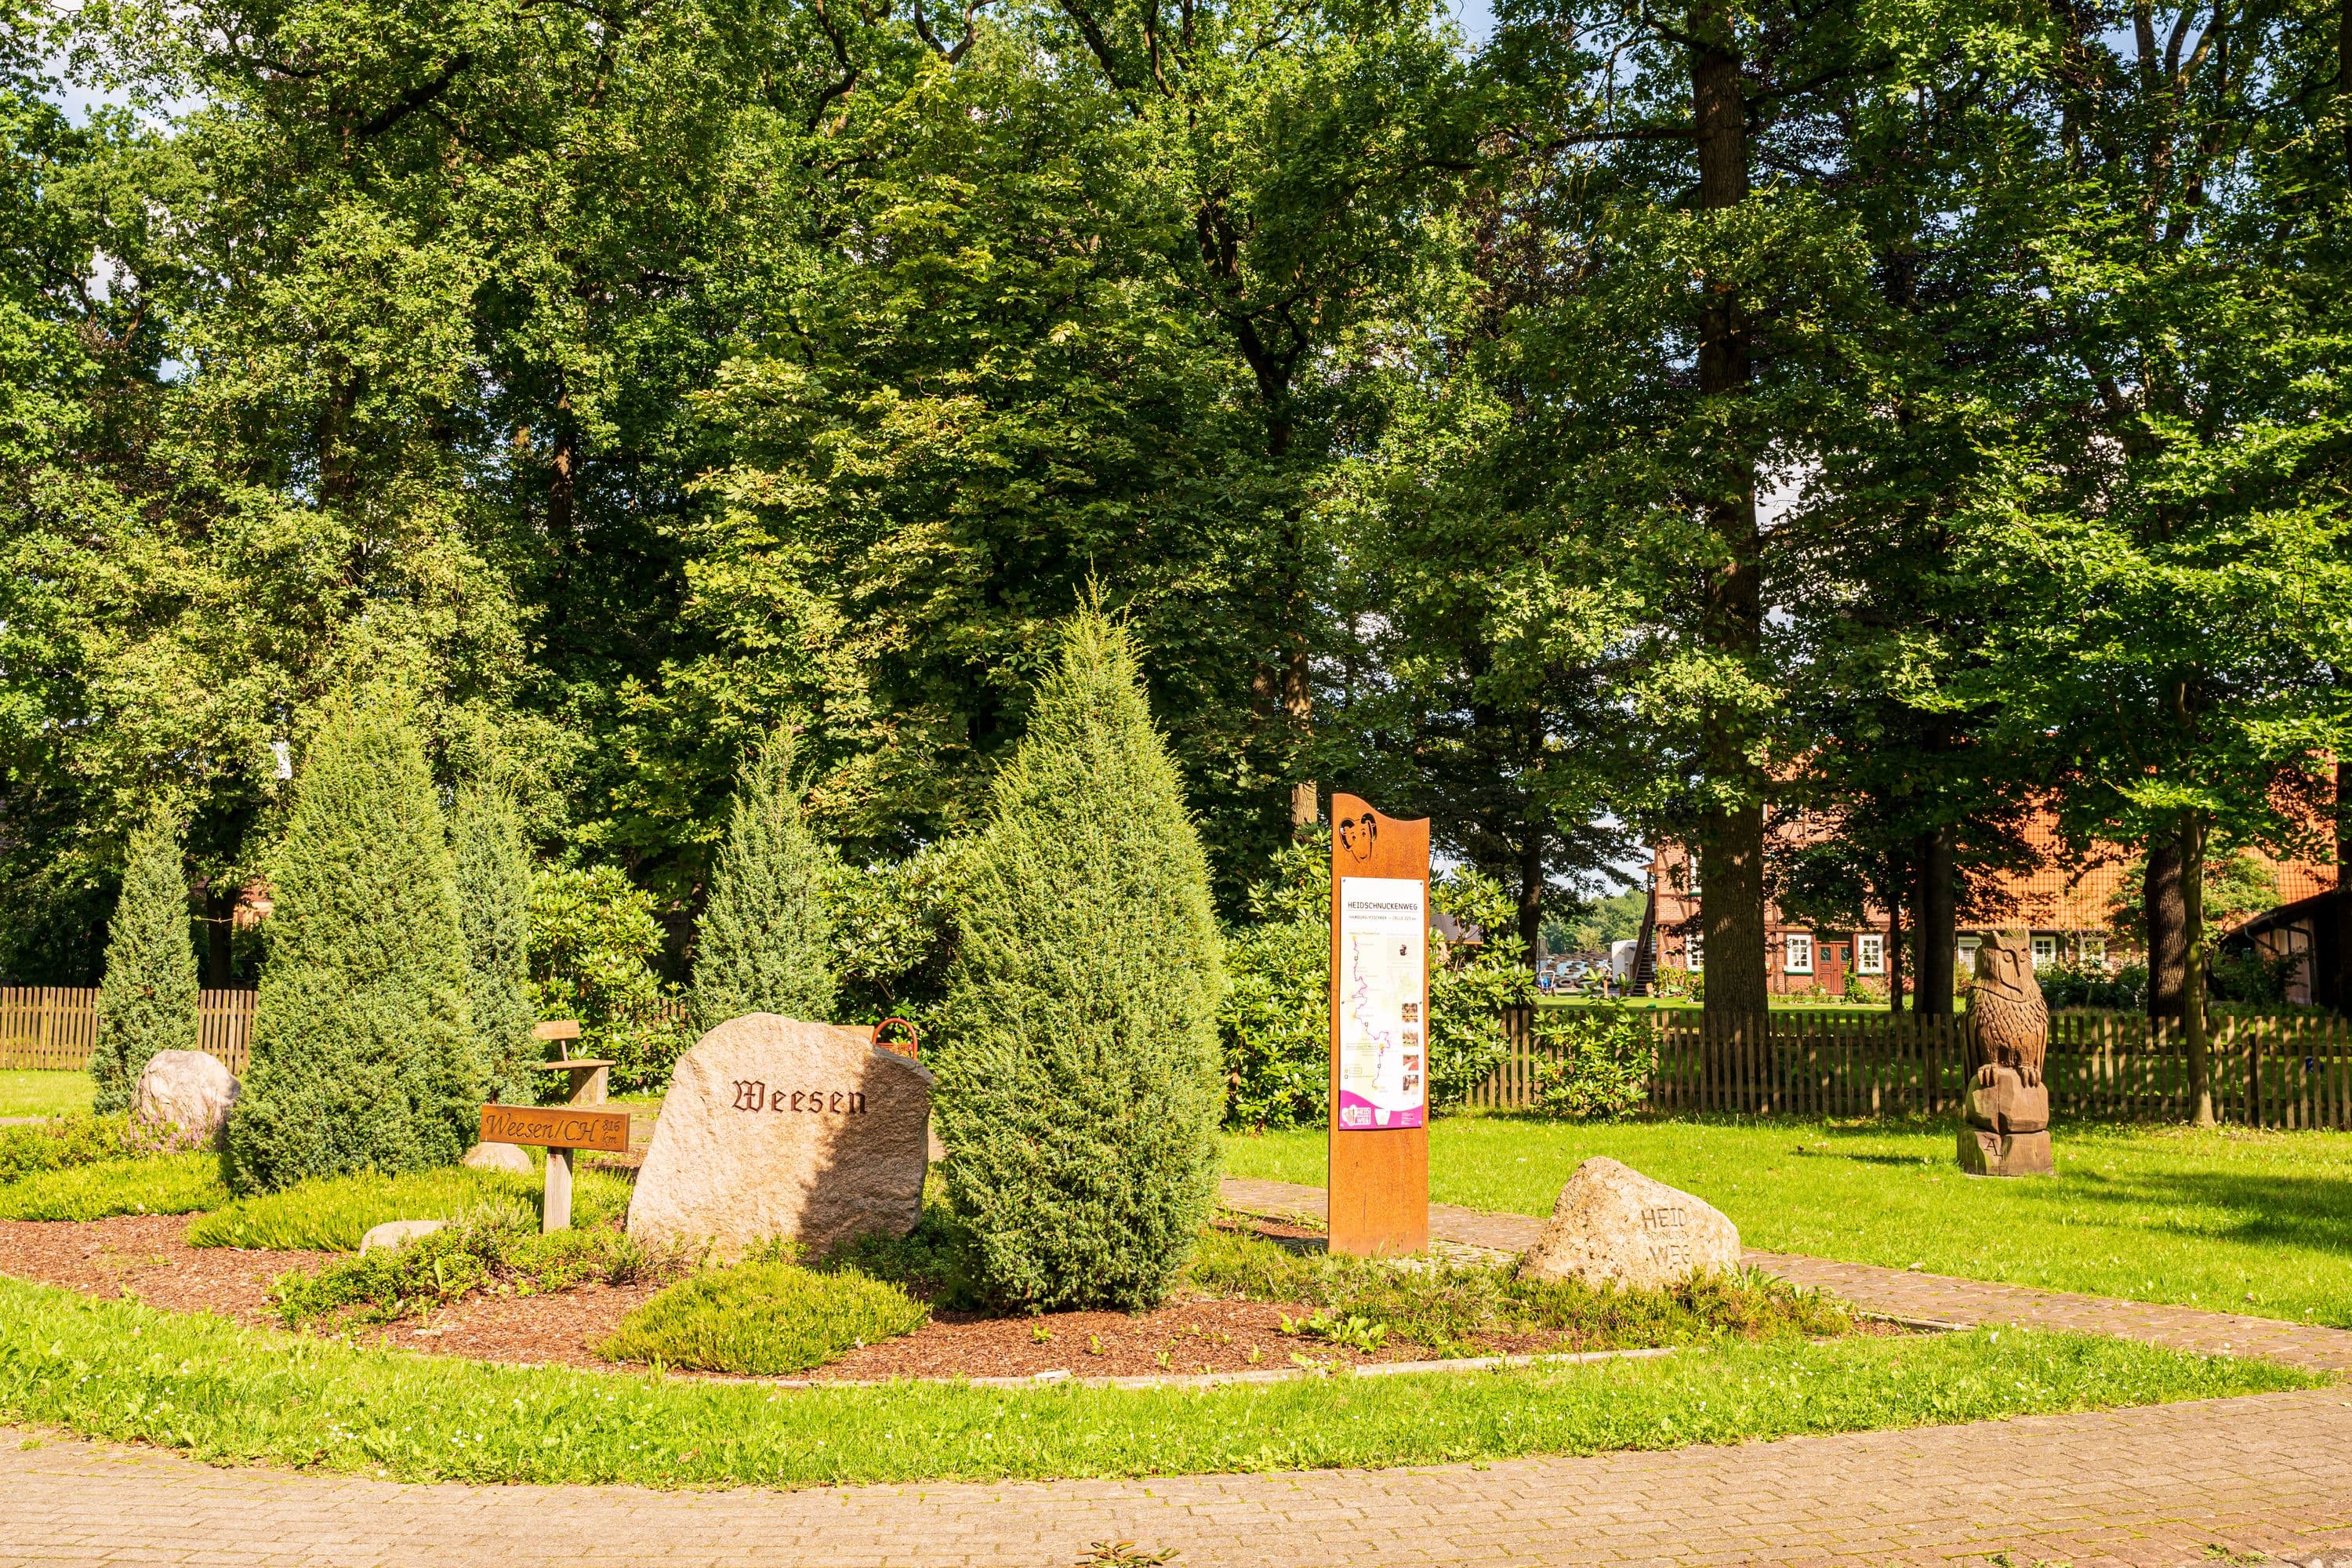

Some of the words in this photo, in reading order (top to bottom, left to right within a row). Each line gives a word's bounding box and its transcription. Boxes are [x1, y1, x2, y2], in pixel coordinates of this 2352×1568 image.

[1348, 901, 1417, 910] HEIDSCHNUCKENWEG
[732, 1080, 867, 1114] Weesen
[486, 1113, 598, 1142] Weesen/CH
[602, 1120, 621, 1132] 816
[601, 1131, 617, 1146] km
[1641, 1208, 1687, 1230] HEID
[1649, 1245, 1690, 1267] WEG
